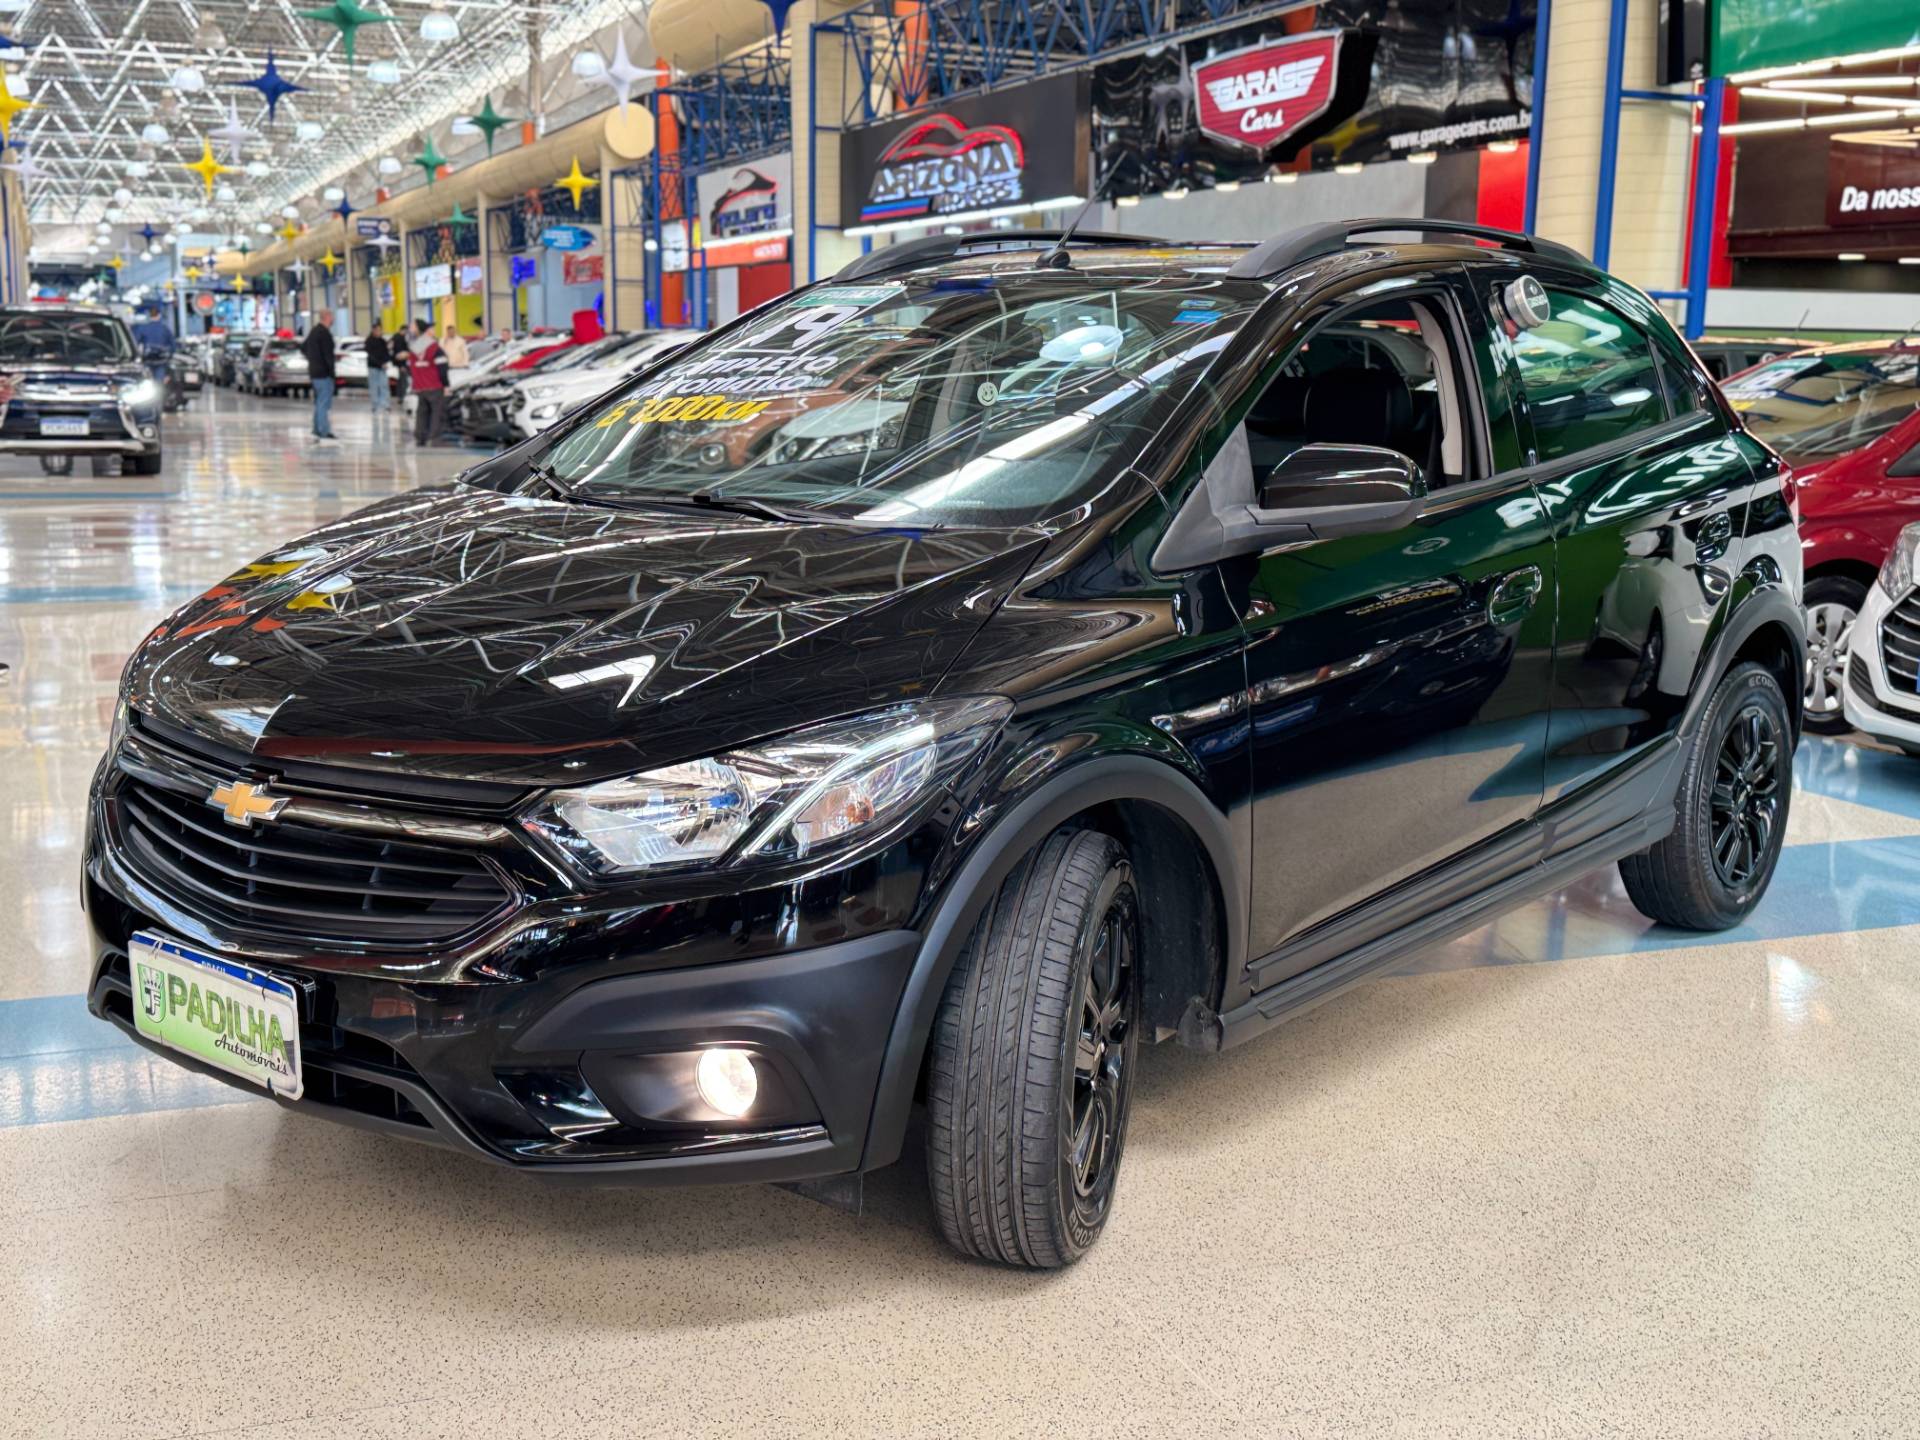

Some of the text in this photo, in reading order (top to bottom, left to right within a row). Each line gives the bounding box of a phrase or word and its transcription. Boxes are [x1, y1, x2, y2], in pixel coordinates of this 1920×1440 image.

[1206, 55, 1325, 112] GARAGE
[1240, 108, 1284, 132] Cars
[868, 142, 1020, 202] ARIZONA
[1840, 186, 1868, 212] Da
[653, 356, 839, 380] COMPLETO
[167, 973, 291, 1066] PADILHA
[215, 1033, 289, 1076] Automóveis
